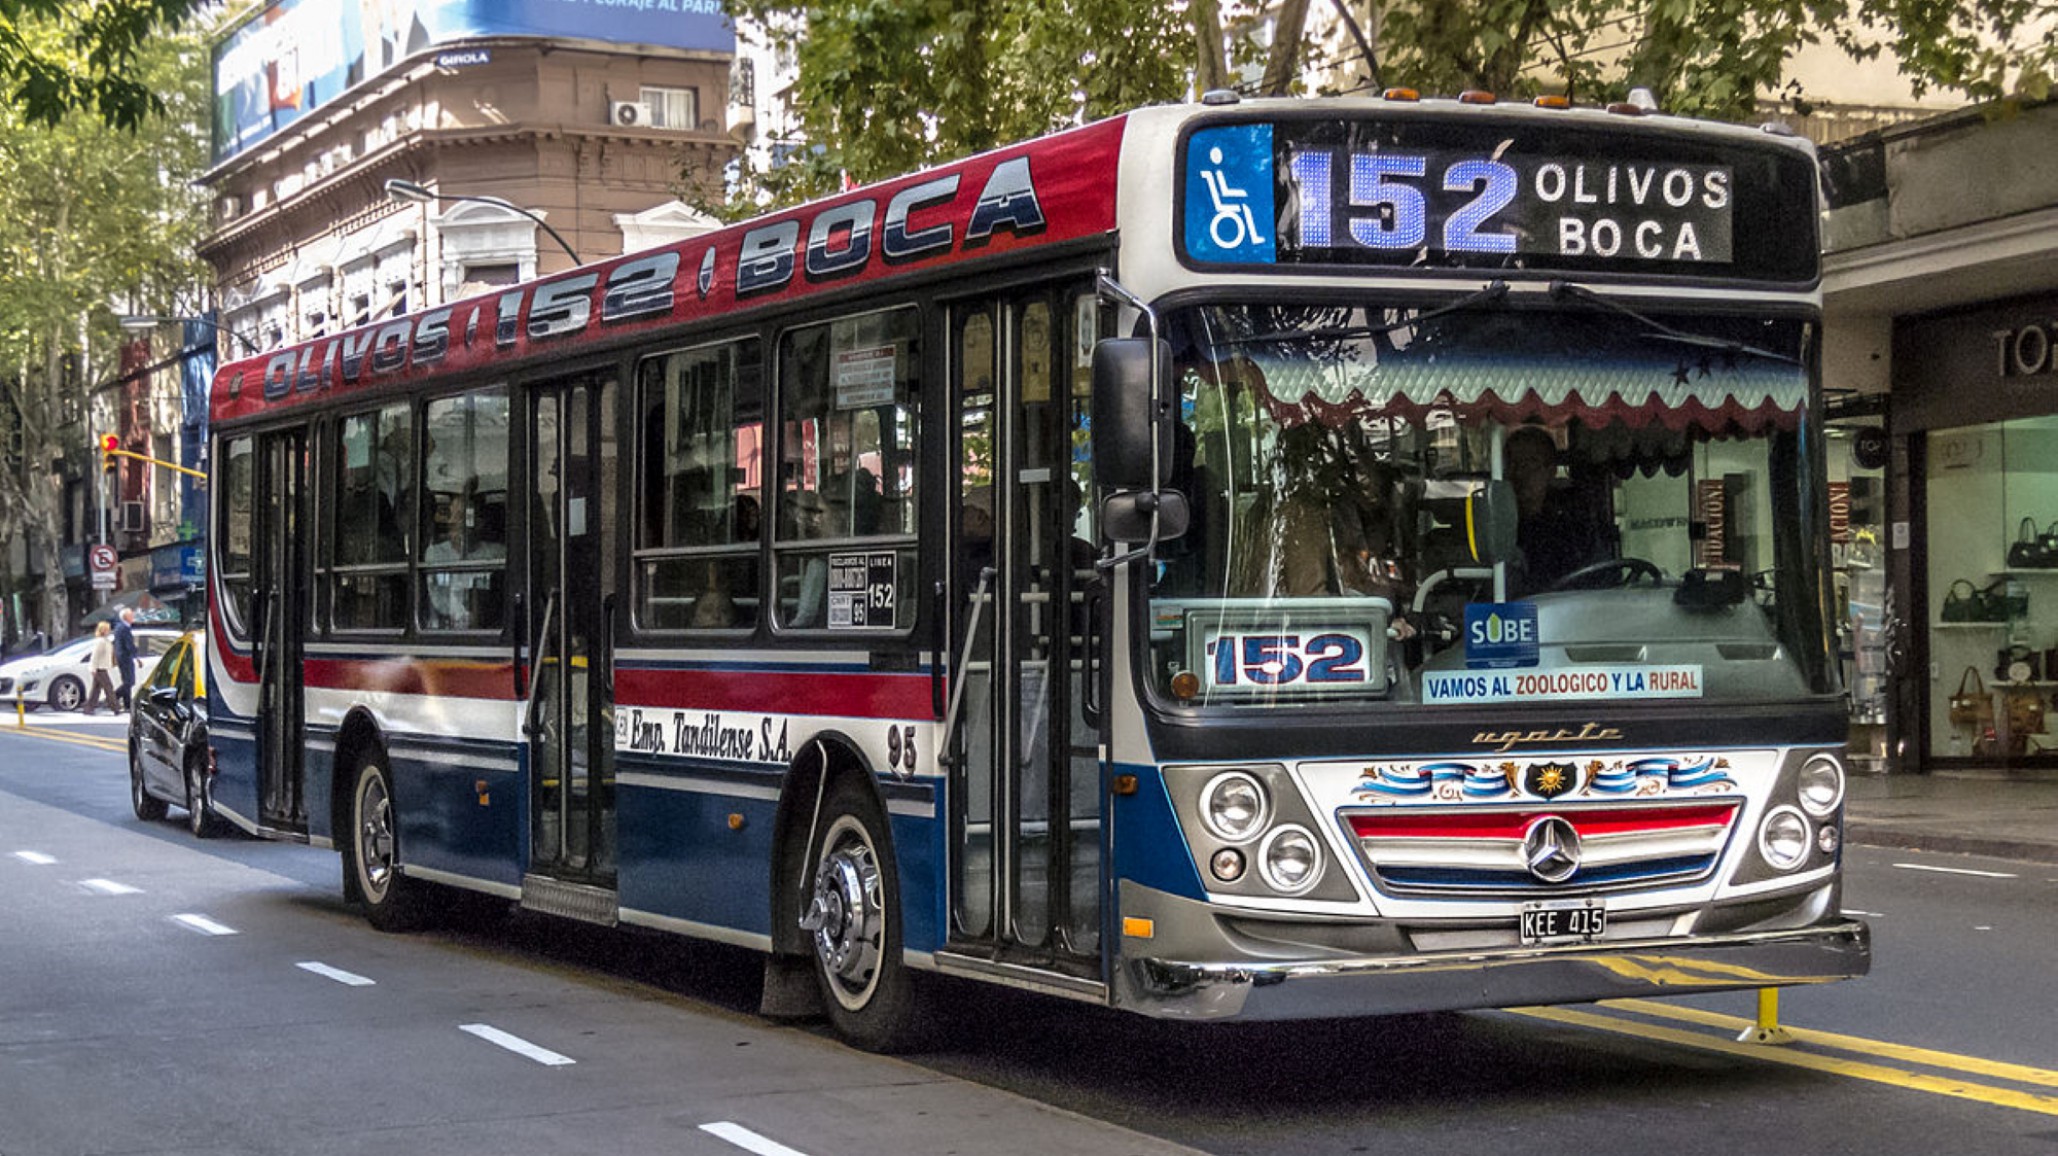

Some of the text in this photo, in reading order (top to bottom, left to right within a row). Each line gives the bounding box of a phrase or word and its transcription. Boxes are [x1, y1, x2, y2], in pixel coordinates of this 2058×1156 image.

[1291, 152, 1728, 254] 152 OLIVOS
[1559, 217, 1702, 261] BOCA
[264, 155, 1048, 400] OLIVOS 152 BOCA
[870, 556, 892, 567] LINEA
[868, 583, 893, 608] 152
[1471, 612, 1532, 644] SUBE
[1207, 633, 1365, 685] 152
[1428, 671, 1698, 698] VAMOS AL ZOOLOGICO Y LA RURAL
[630, 709, 665, 755] Emp.
[674, 712, 753, 760] Tandilense
[759, 716, 792, 763] S.A.
[887, 724, 917, 769] 95
[1525, 909, 1603, 937] KEE 415
